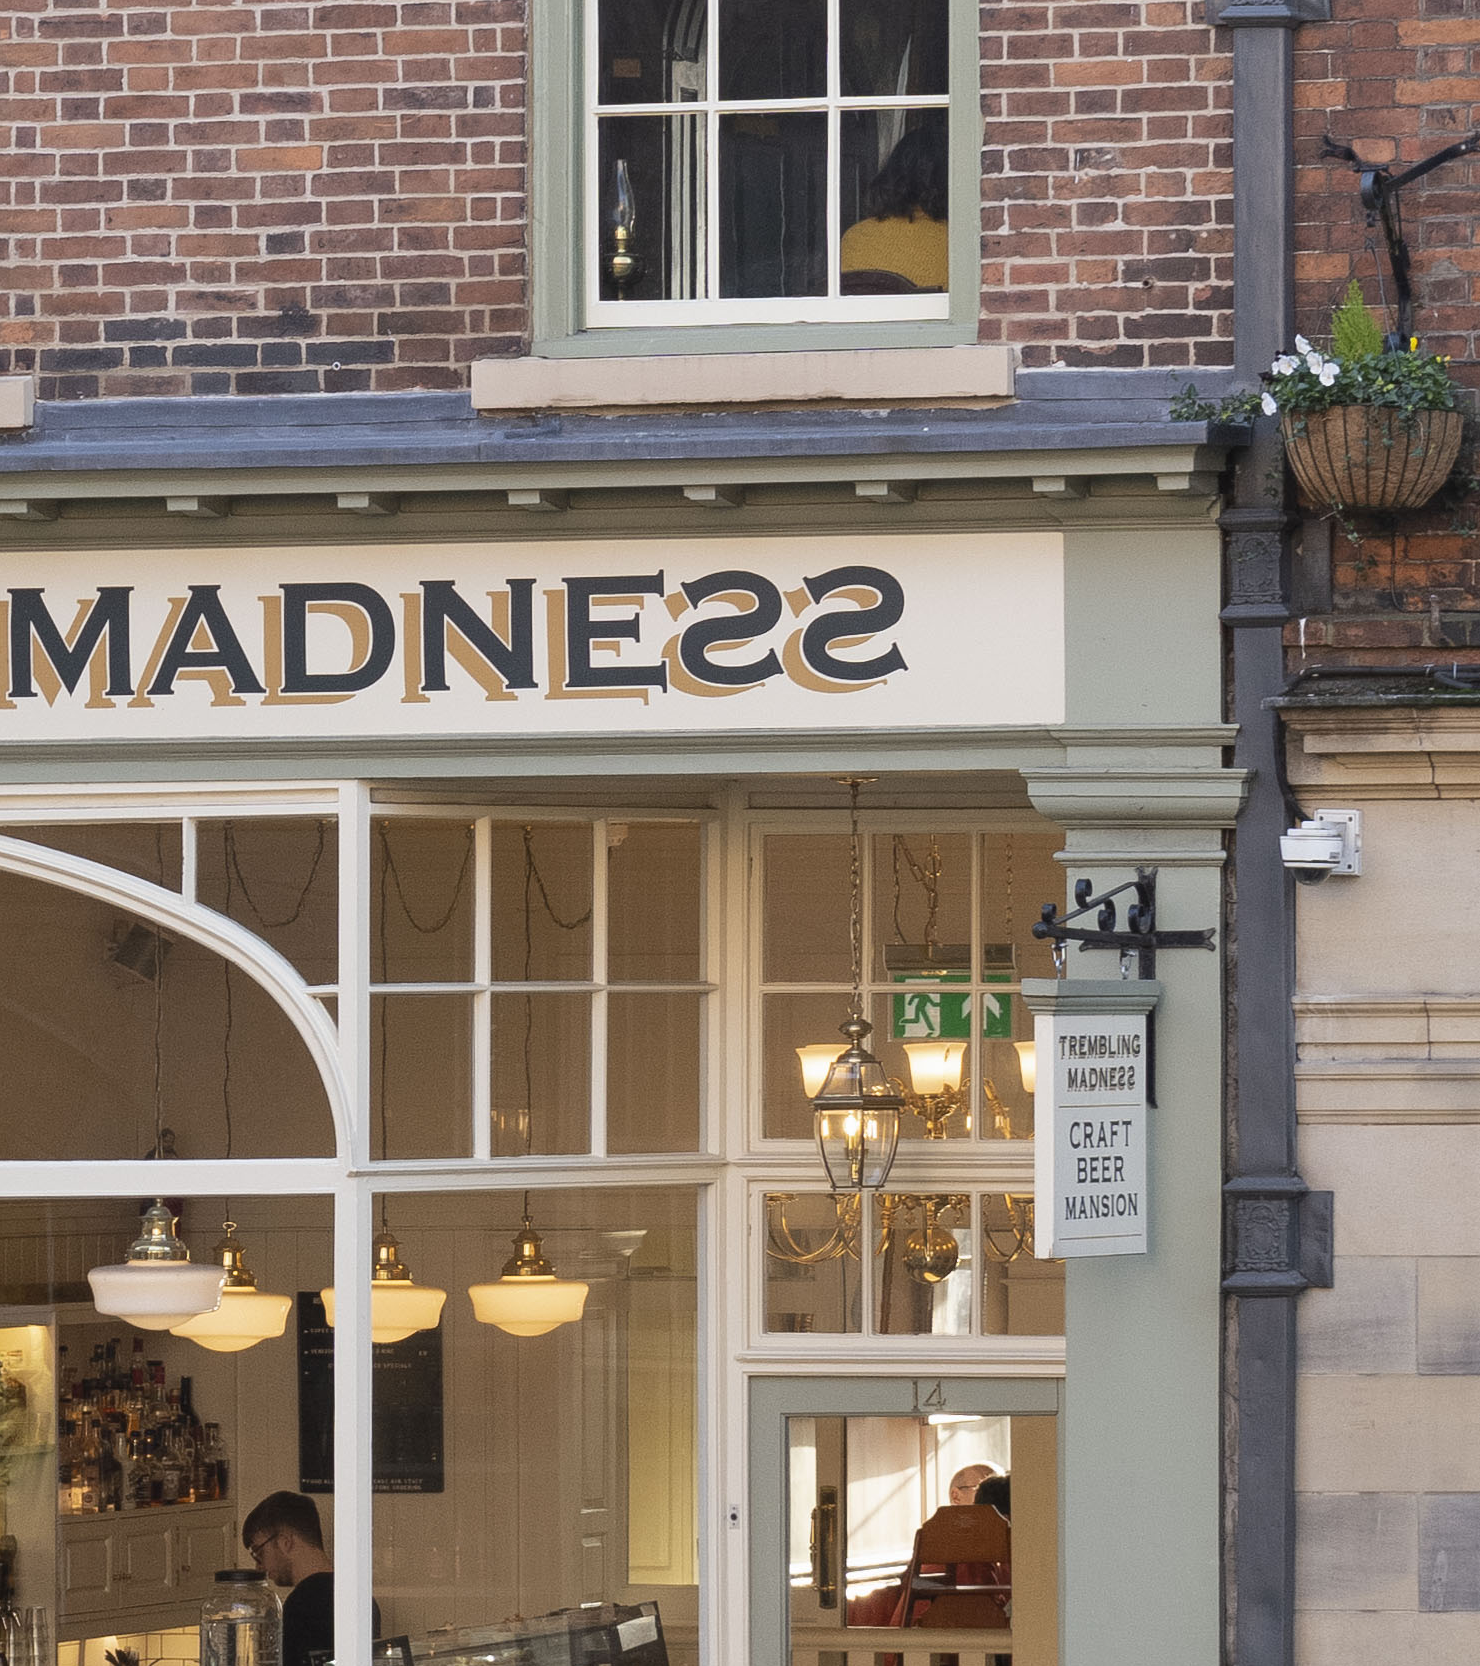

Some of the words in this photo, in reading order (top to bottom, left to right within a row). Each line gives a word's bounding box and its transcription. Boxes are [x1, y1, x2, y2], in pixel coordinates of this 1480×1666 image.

[1059, 1034, 1141, 1059] TREMBLING
[1067, 1066, 1136, 1091] MADNESS
[1069, 1120, 1132, 1149] CRAFT
[1077, 1156, 1124, 1184] BEER
[1065, 1193, 1138, 1220] MANSION
[911, 1379, 946, 1412] 14
